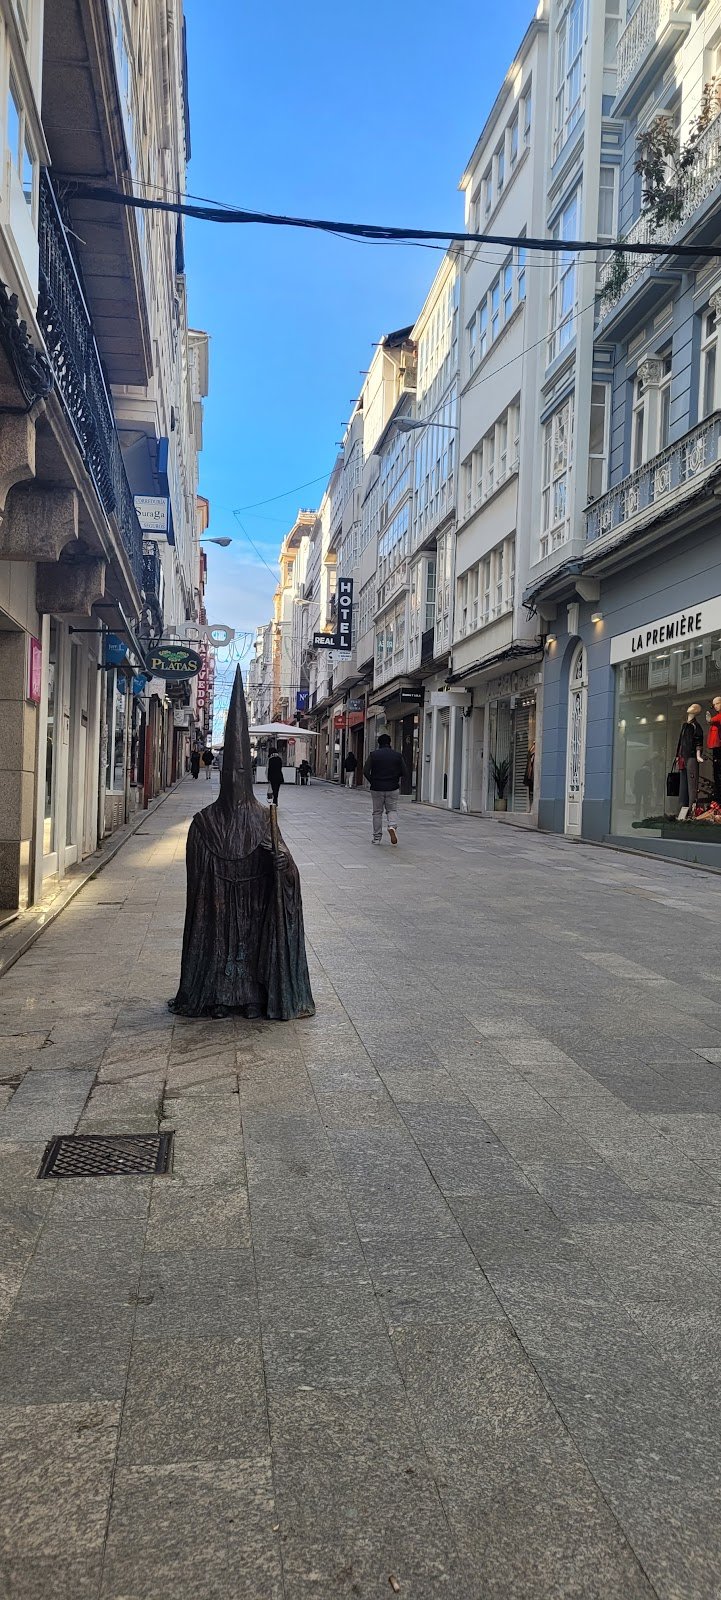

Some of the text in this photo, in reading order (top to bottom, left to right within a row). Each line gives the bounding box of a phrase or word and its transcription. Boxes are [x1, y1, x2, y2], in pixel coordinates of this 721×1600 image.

[340, 582, 351, 647] HOTEL
[315, 637, 335, 645] REAL
[631, 612, 702, 653] LA PREMIÈRE
[151, 658, 197, 672] PLATAS
